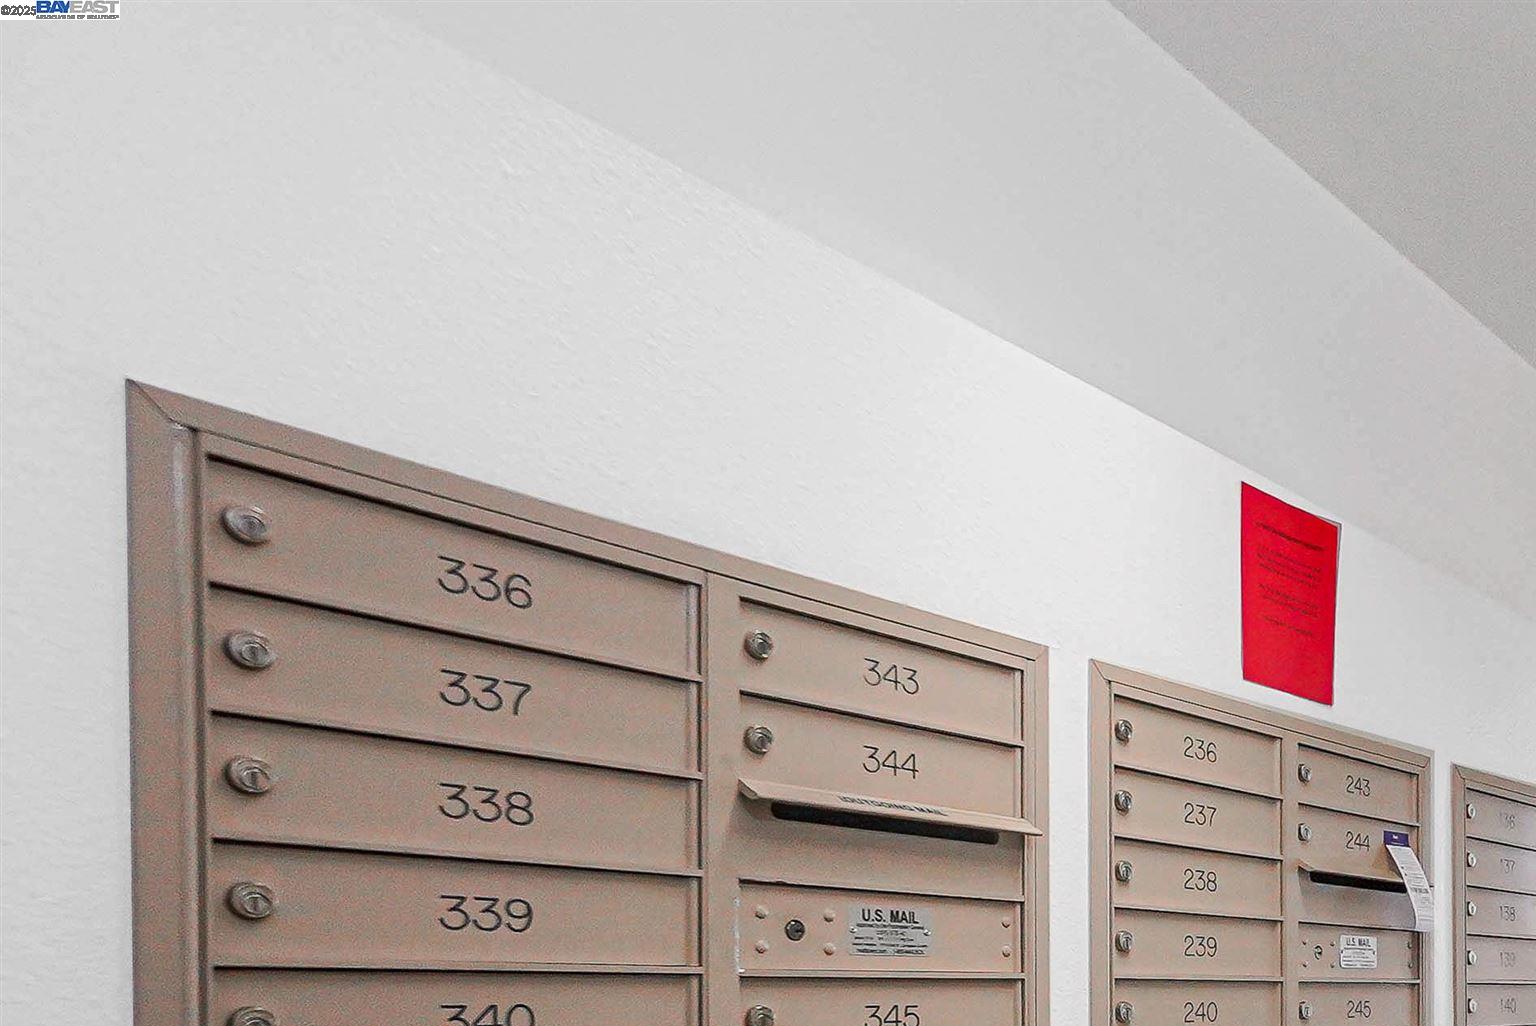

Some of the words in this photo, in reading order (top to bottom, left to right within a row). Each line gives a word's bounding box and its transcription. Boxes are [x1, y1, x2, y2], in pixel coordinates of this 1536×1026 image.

[438, 556, 533, 609] 336
[864, 658, 919, 695] 343
[440, 669, 531, 716] 337
[1183, 736, 1217, 763] 236
[863, 746, 919, 779] 344
[1345, 775, 1371, 798] 243
[438, 782, 535, 826] 338
[1184, 802, 1216, 827] 237
[1345, 831, 1371, 852] 244
[1184, 868, 1217, 892] 238
[438, 895, 534, 933] 339
[862, 908, 886, 922] U.S.
[890, 910, 919, 924] MAIL
[1184, 935, 1217, 958] 239
[1184, 1001, 1218, 1023] 240
[1346, 1000, 1371, 1019] 245
